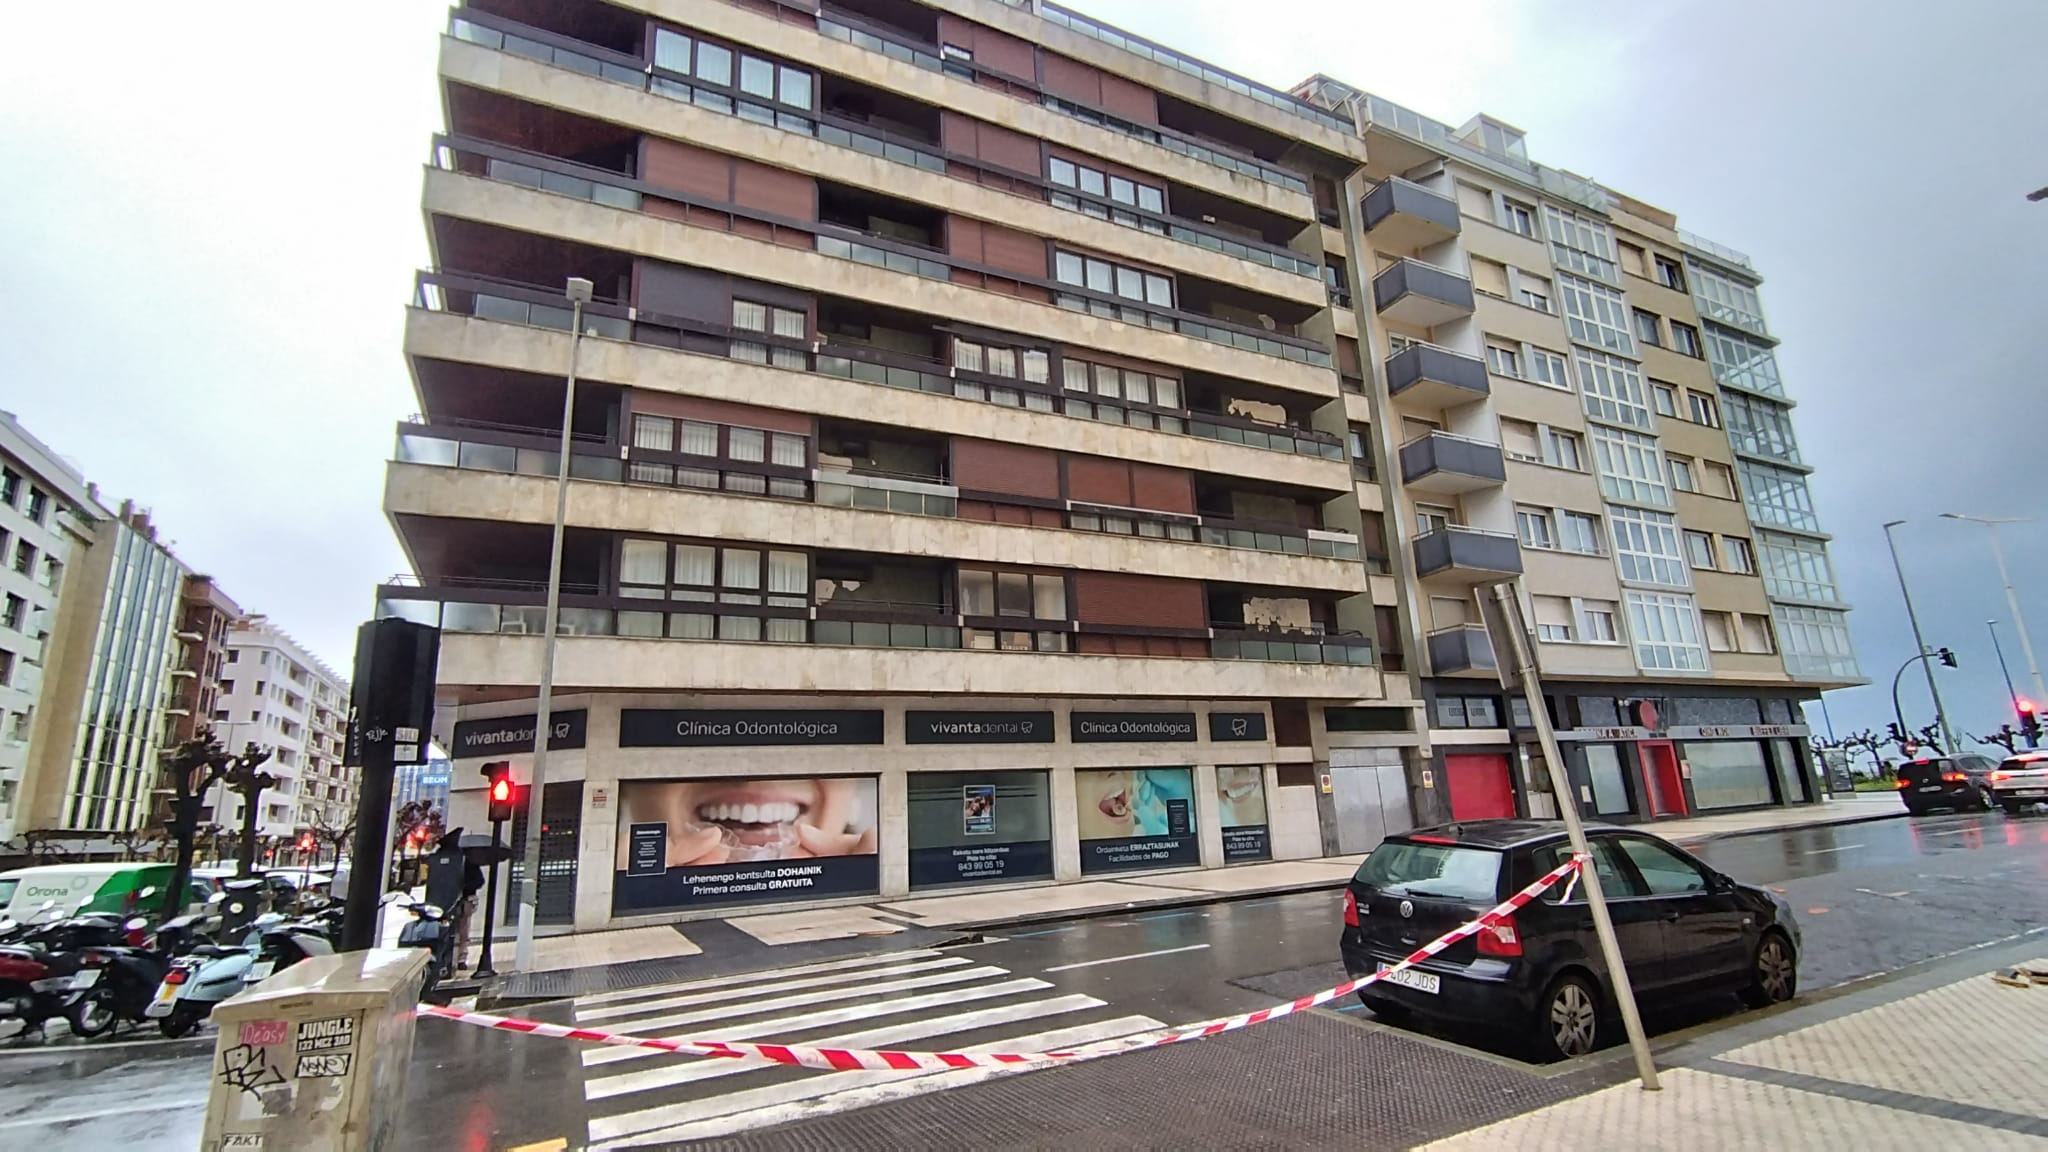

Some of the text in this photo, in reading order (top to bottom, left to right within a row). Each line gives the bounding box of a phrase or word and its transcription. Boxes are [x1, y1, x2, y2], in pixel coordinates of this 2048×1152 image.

[465, 725, 553, 746] vivantadenl
[677, 720, 838, 737] Clínica Odontológica
[930, 721, 1018, 734] vivantadental
[1120, 721, 1191, 736] Odontológica
[1152, 851, 1169, 859] PAGO
[984, 860, 994, 869] 05
[995, 859, 1005, 868] 19
[683, 866, 823, 884] Lehenengo kontsulta DOHAINIK
[26, 886, 69, 897] Orona
[692, 877, 814, 895] Primera consulta GRATUITA
[1414, 970, 1437, 991] JDS
[298, 1018, 353, 1040] JUNGLE
